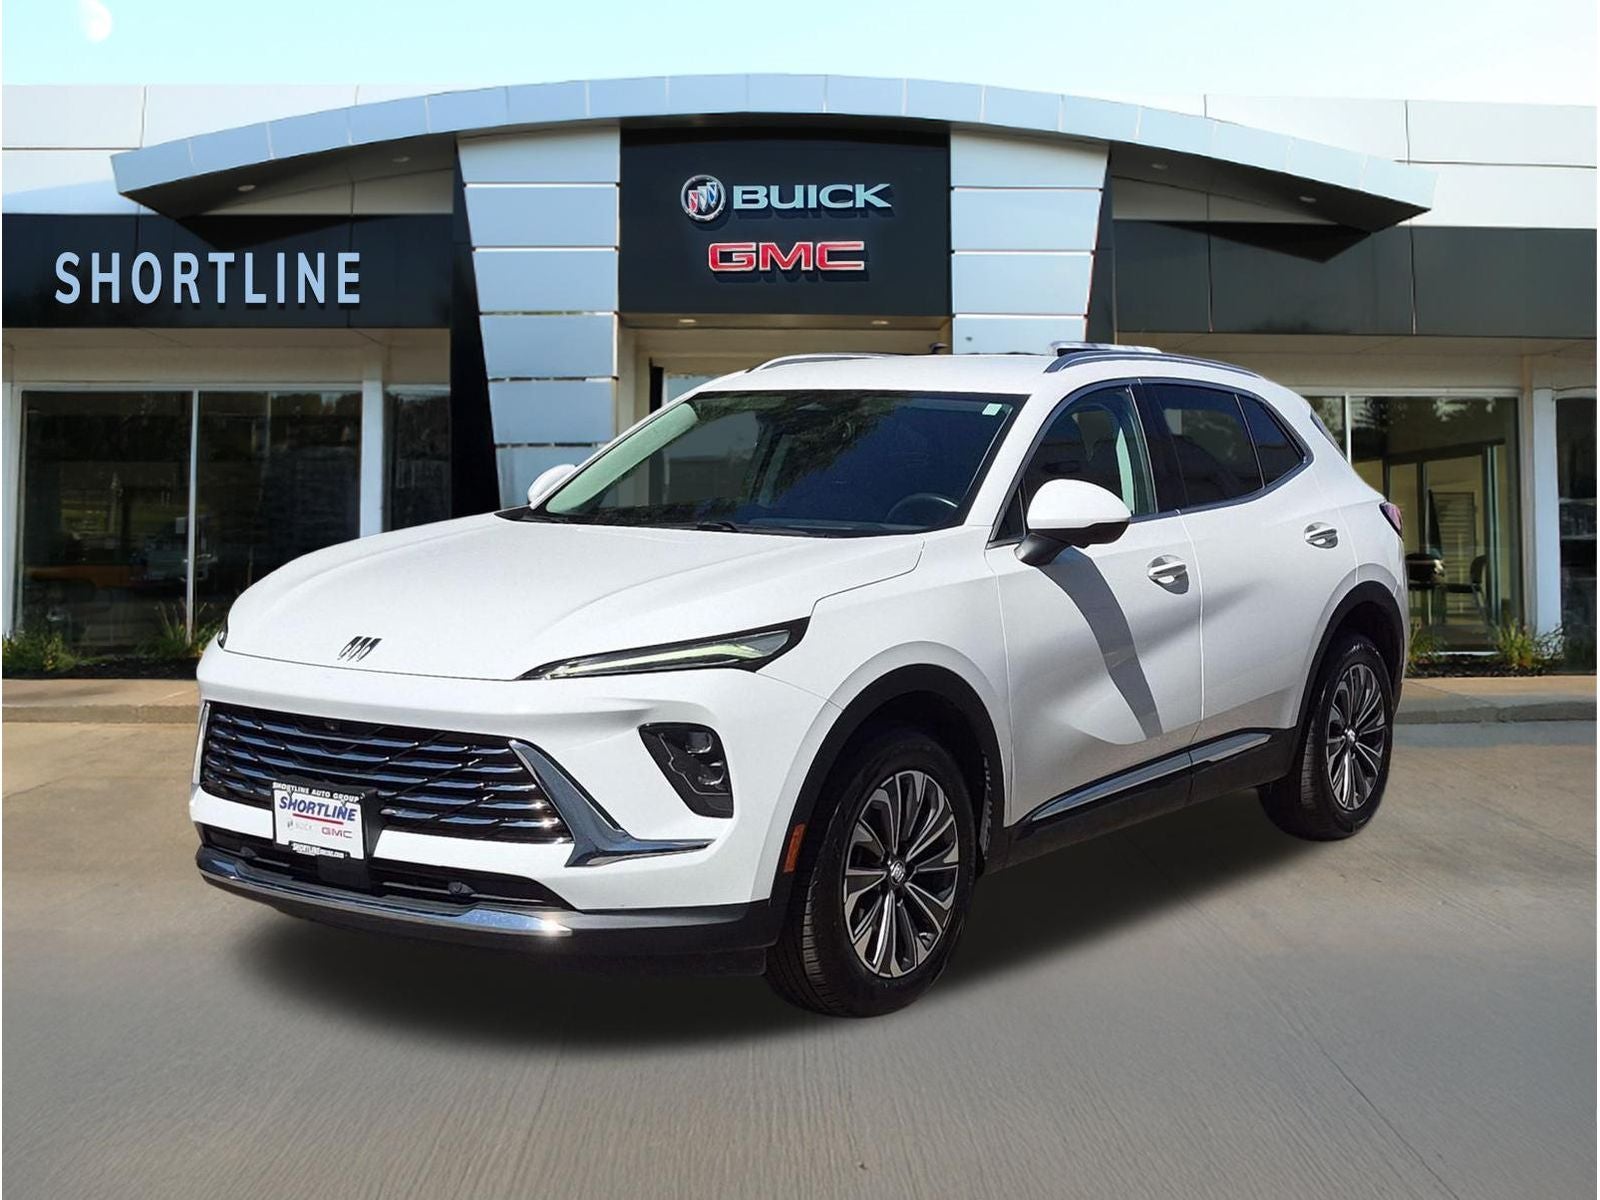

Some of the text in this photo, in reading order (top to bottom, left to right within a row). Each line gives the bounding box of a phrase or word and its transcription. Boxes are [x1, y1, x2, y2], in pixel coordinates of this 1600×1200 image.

[733, 183, 892, 209] BUICK
[708, 241, 865, 272] GMC
[55, 252, 360, 304] SHORTLINE
[272, 782, 359, 802] SHORTLINE AUTO GROUP
[279, 796, 357, 821] SHORTLINE
[321, 826, 352, 838] GMC
